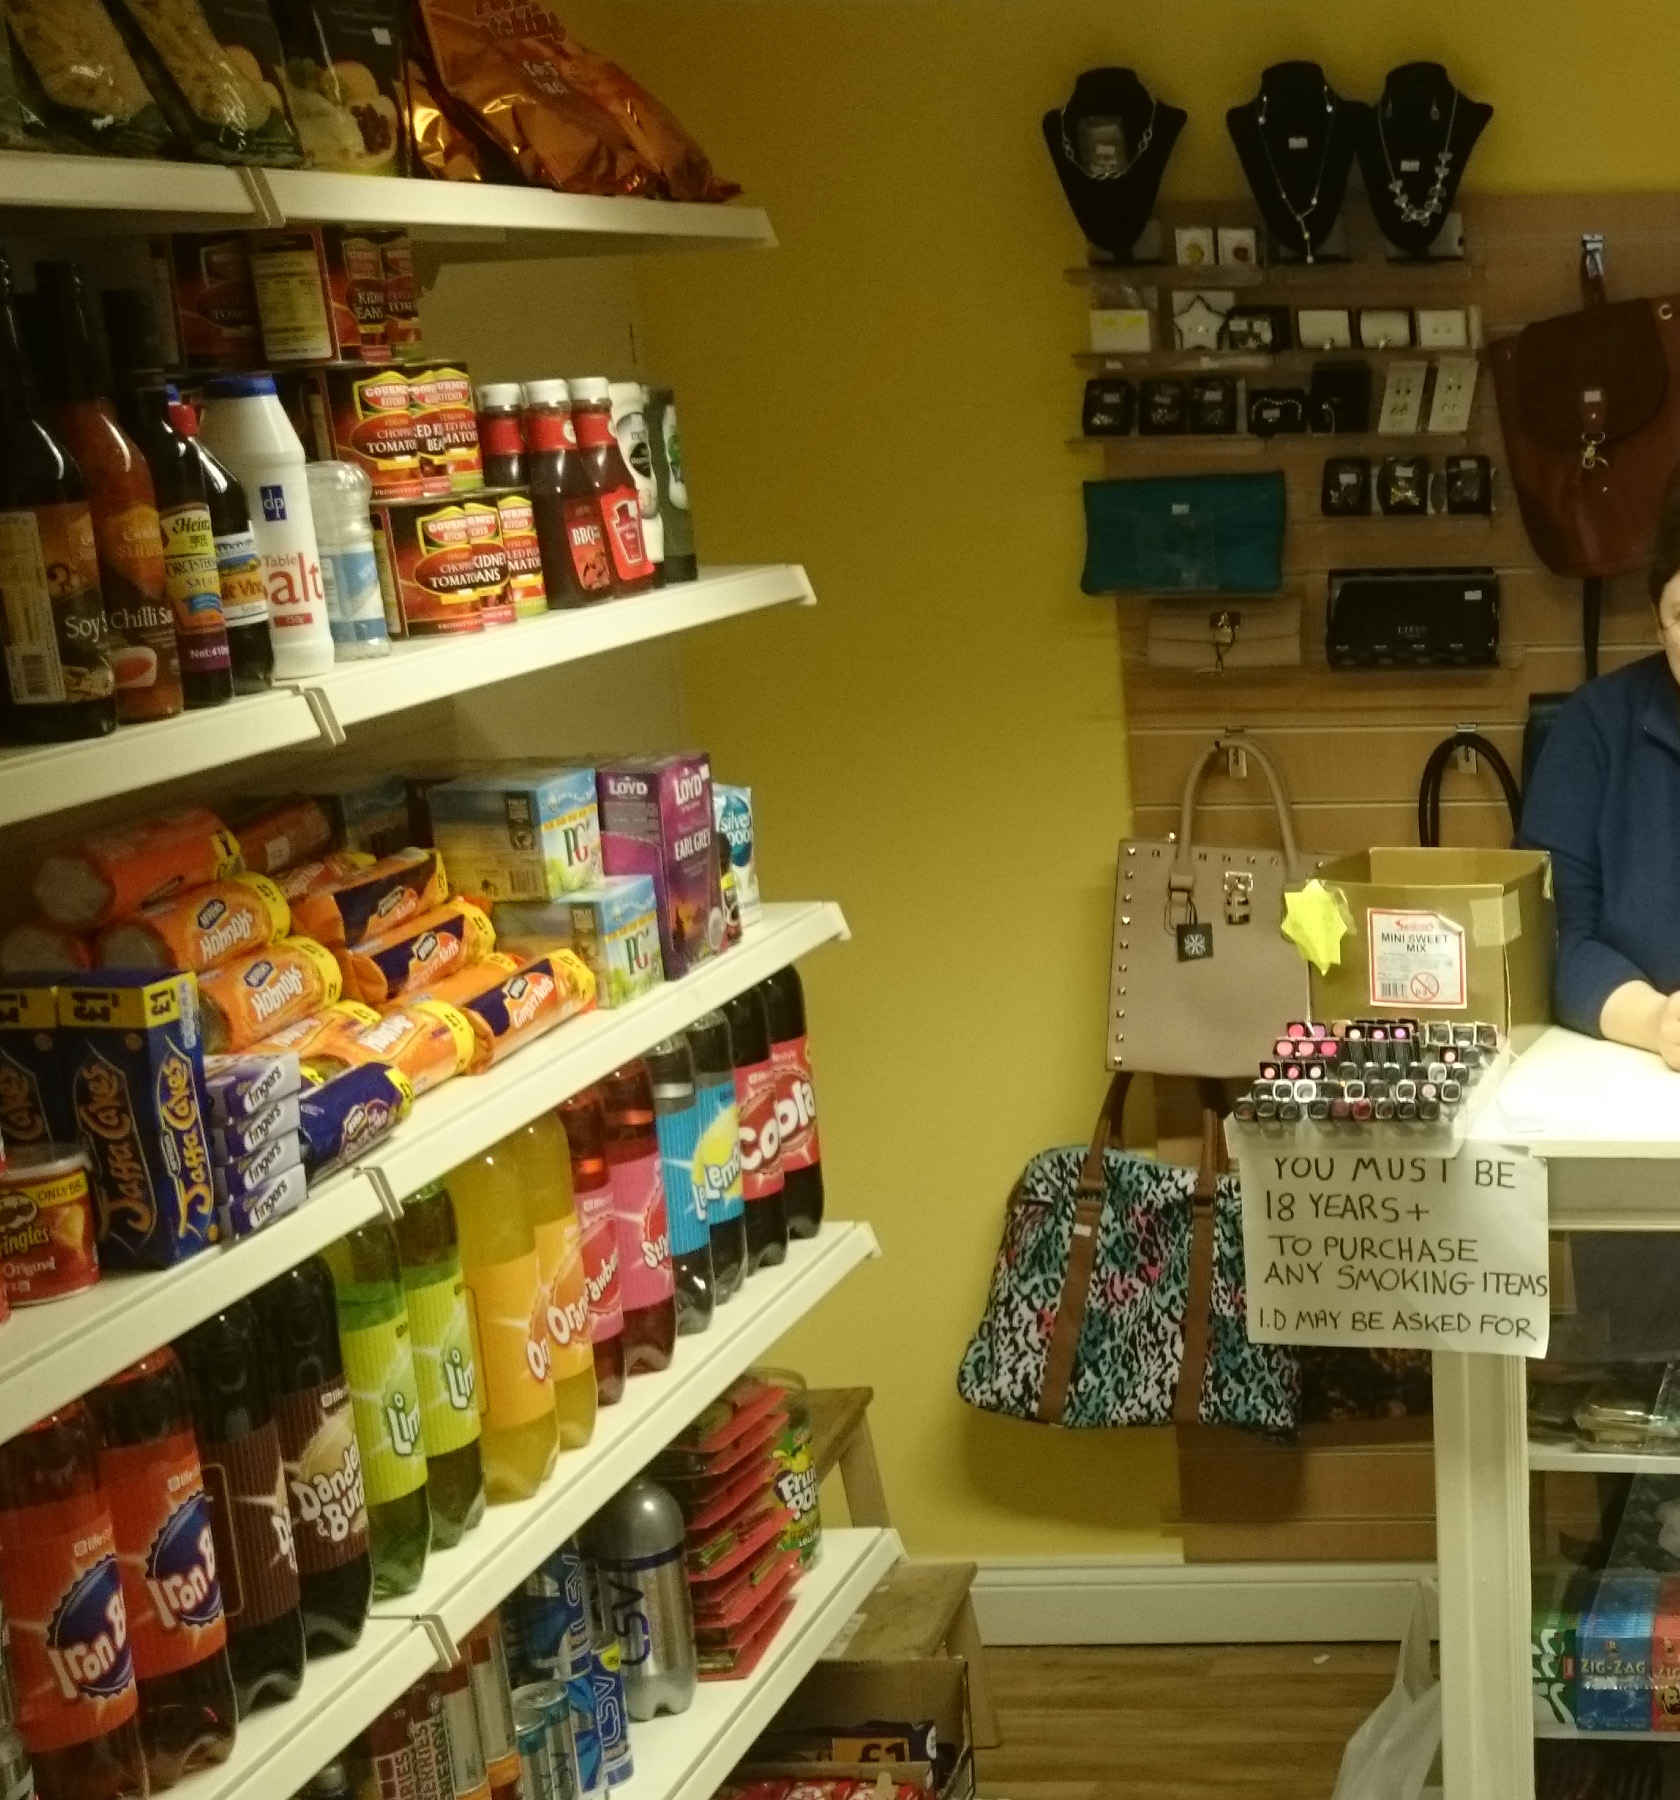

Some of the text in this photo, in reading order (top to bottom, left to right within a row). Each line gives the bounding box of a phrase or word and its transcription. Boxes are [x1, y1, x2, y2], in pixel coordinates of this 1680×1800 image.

[571, 527, 594, 546] BBQ
[262, 552, 298, 569] Table
[266, 552, 323, 606] alt
[65, 612, 101, 643] Soy
[110, 606, 157, 630] Chilli
[609, 778, 648, 796] LOYD
[1381, 933, 1448, 944] MINI SWEET
[1406, 944, 1427, 953] MIX
[249, 1065, 282, 1107] fingers
[249, 1104, 282, 1145] fingers
[774, 1080, 816, 1138] ola
[249, 1143, 282, 1184] fingers
[1275, 1157, 1516, 1189] YOU MUST BE
[253, 1183, 288, 1226] fingers
[1266, 1190, 1295, 1222] 18
[4, 1224, 49, 1255] ingles
[1268, 1235, 1479, 1263] TO PURCHASE
[1264, 1262, 1548, 1297] ANY SMOKING ITEMS
[1296, 1310, 1341, 1331] MAY
[1352, 1312, 1384, 1332] BE
[1393, 1312, 1471, 1334] ASKED
[1480, 1314, 1537, 1341] FOR
[1580, 1658, 1648, 1674] ZIG-ZAG
